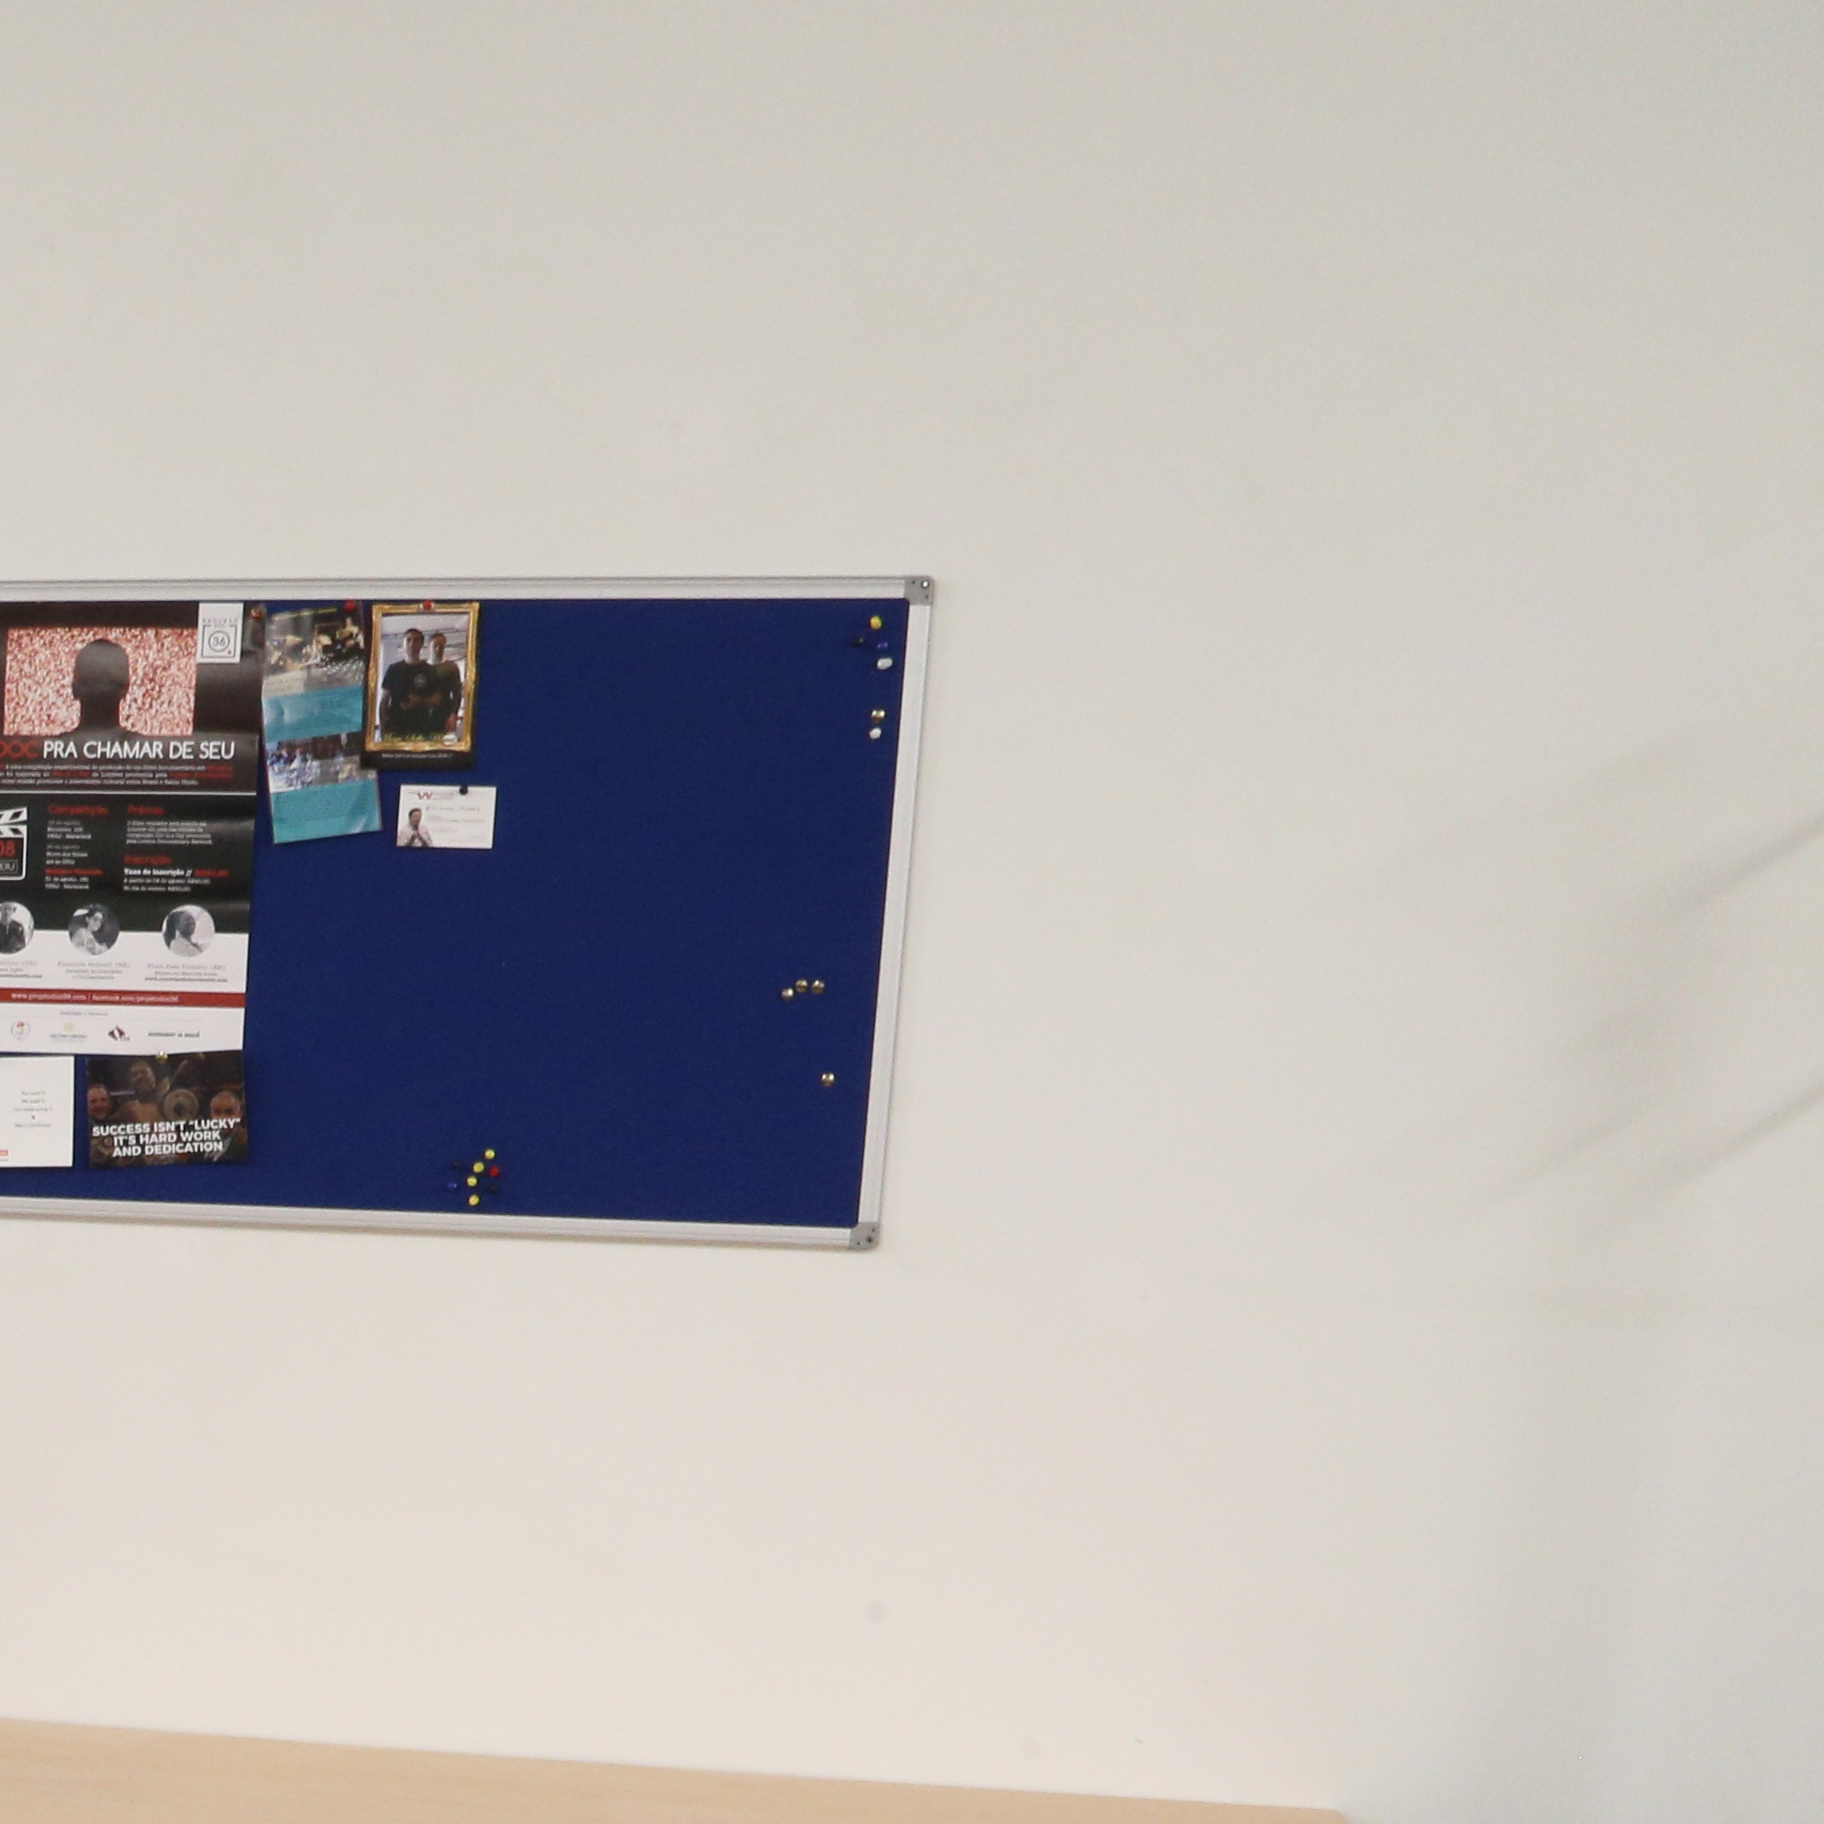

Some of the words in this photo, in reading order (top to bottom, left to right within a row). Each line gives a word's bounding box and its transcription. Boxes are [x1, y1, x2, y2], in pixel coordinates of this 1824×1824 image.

[43, 741, 78, 759] PRA
[83, 741, 164, 759] CHAMAR
[169, 741, 195, 759] DE
[199, 741, 236, 760] SEU
[92, 1122, 151, 1137] SUCCESS
[153, 1120, 186, 1133] ISN'T
[188, 1117, 241, 1131] "LUCKY"
[113, 1135, 137, 1147] IT'S
[139, 1132, 178, 1145] HARD
[180, 1130, 222, 1143] WORK
[112, 1146, 142, 1158] AND
[144, 1140, 223, 1156] DEDICATION
